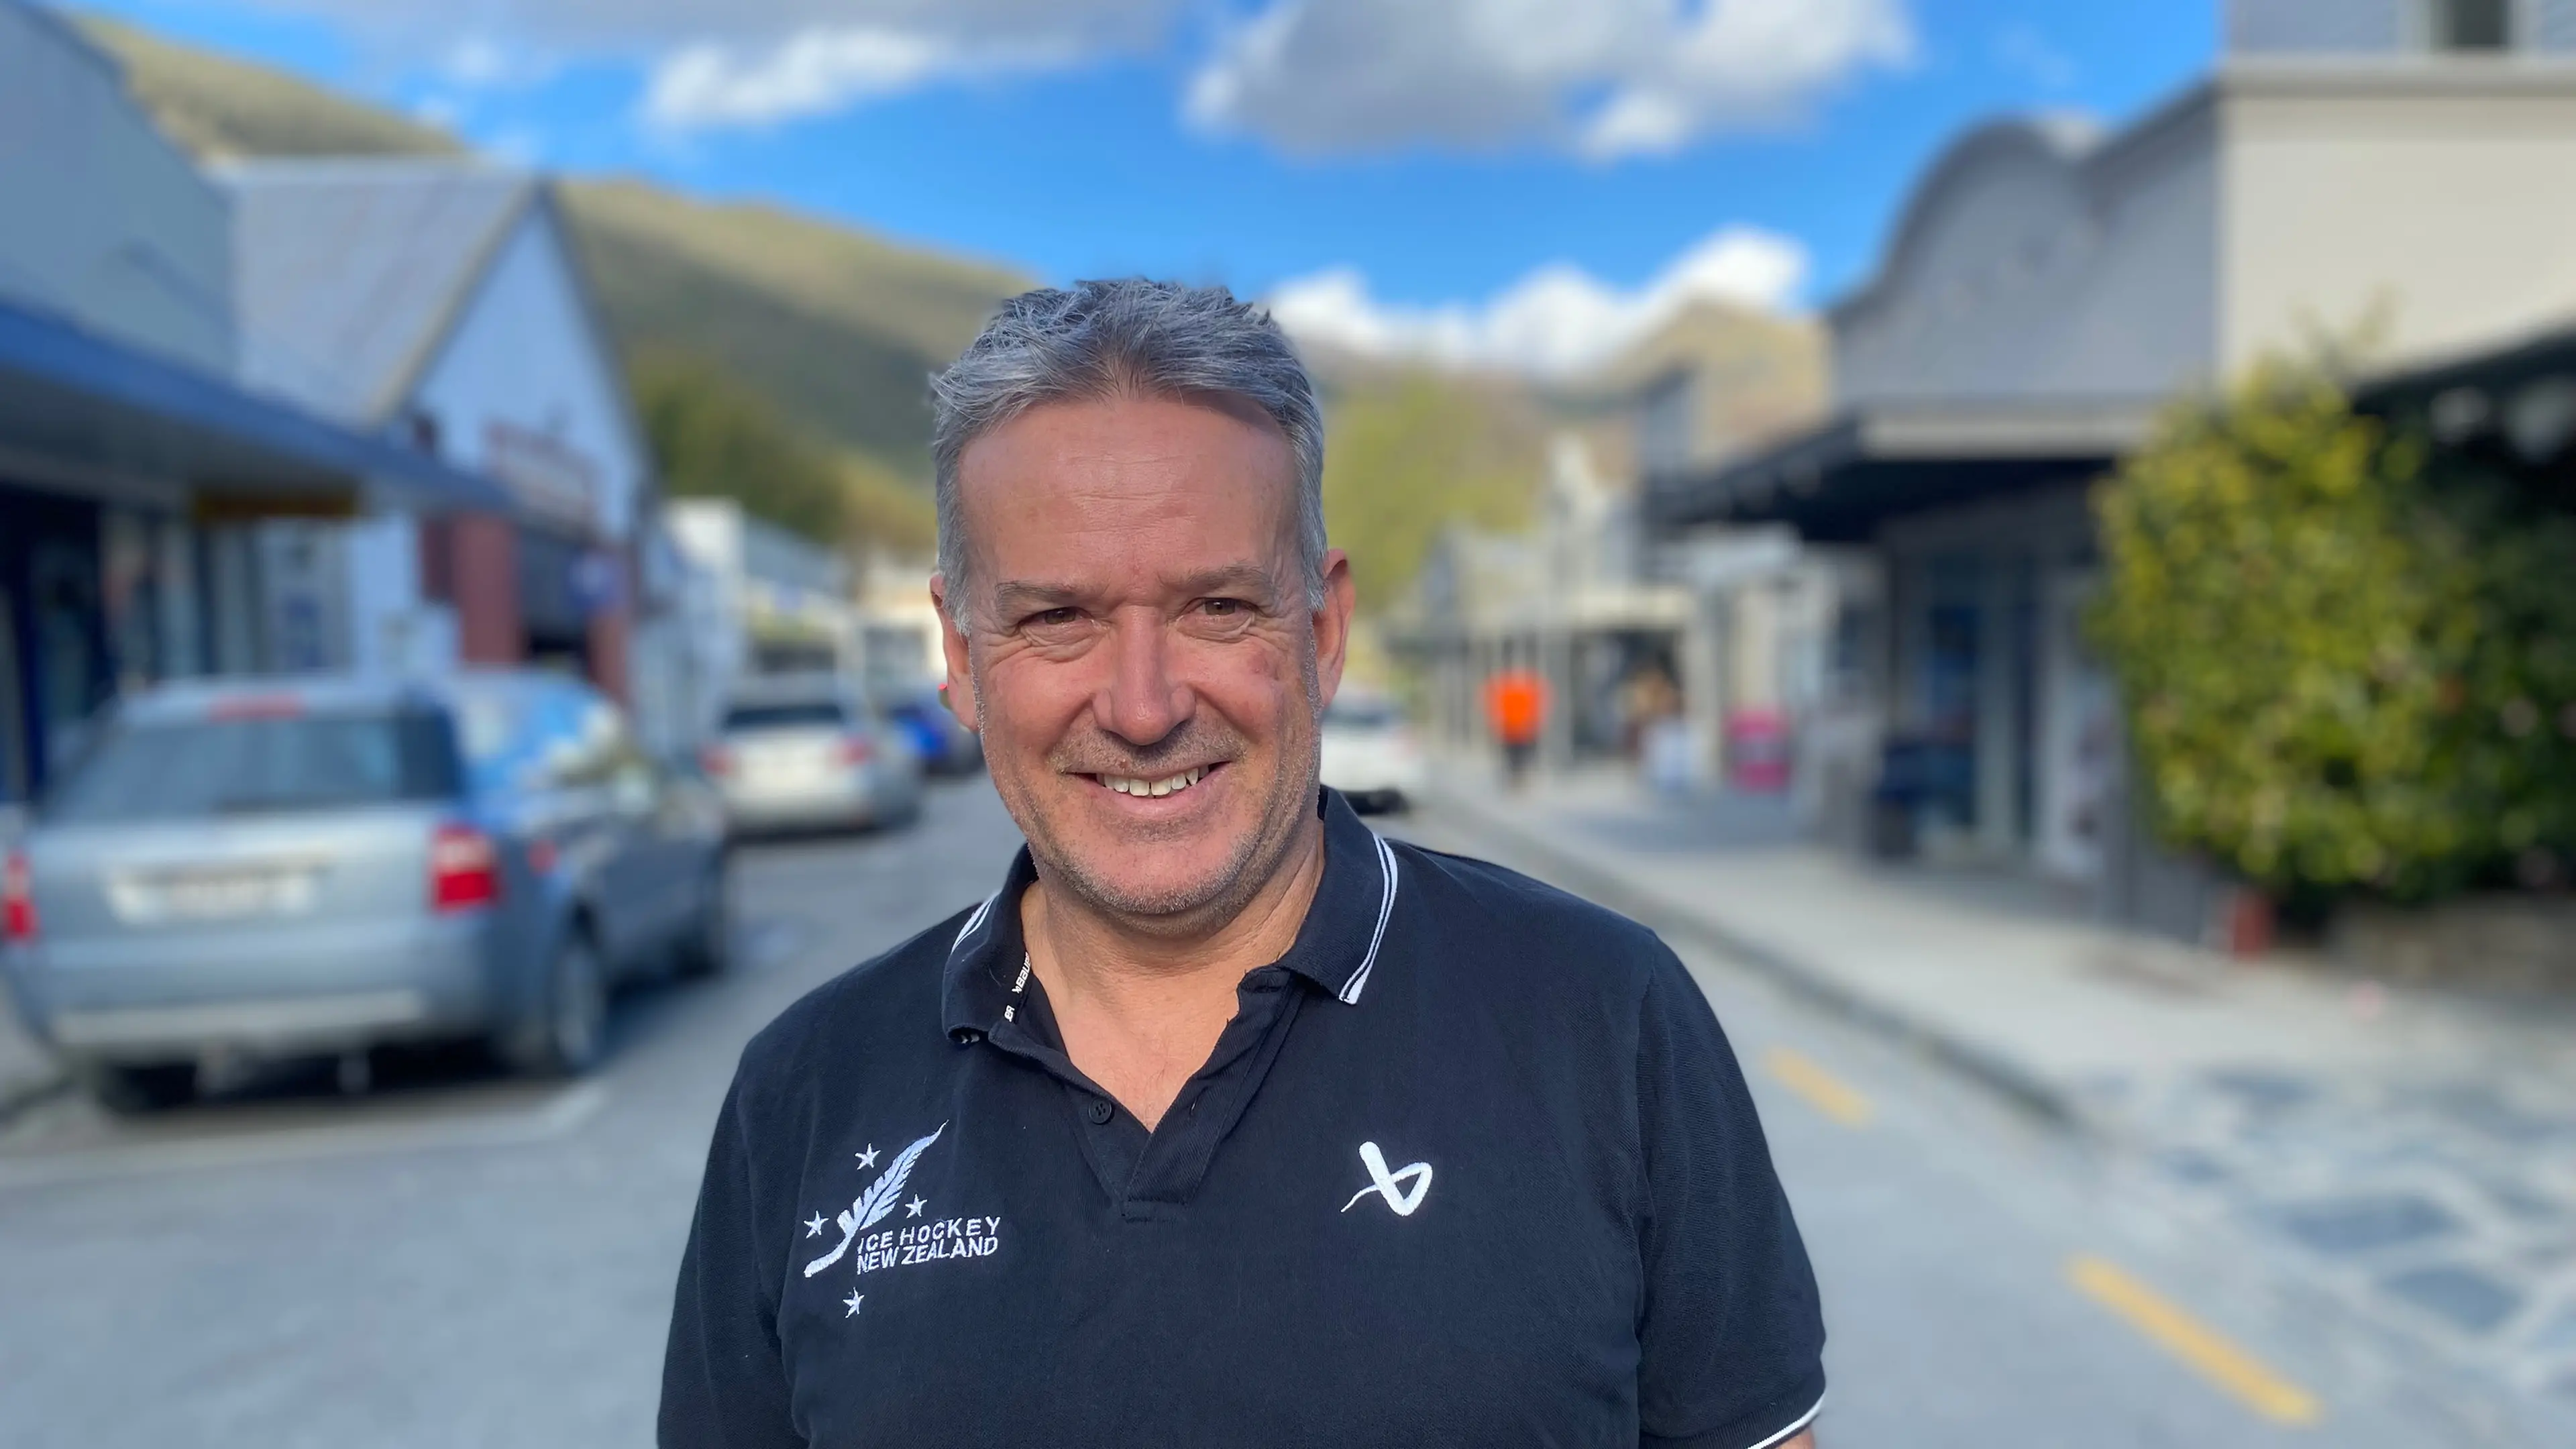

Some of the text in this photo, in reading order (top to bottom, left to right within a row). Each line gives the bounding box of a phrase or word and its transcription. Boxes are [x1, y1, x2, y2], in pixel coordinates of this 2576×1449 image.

[857, 1216, 1001, 1254] ICE HOCKEY
[857, 1236, 998, 1275] NEW ZEALAND
